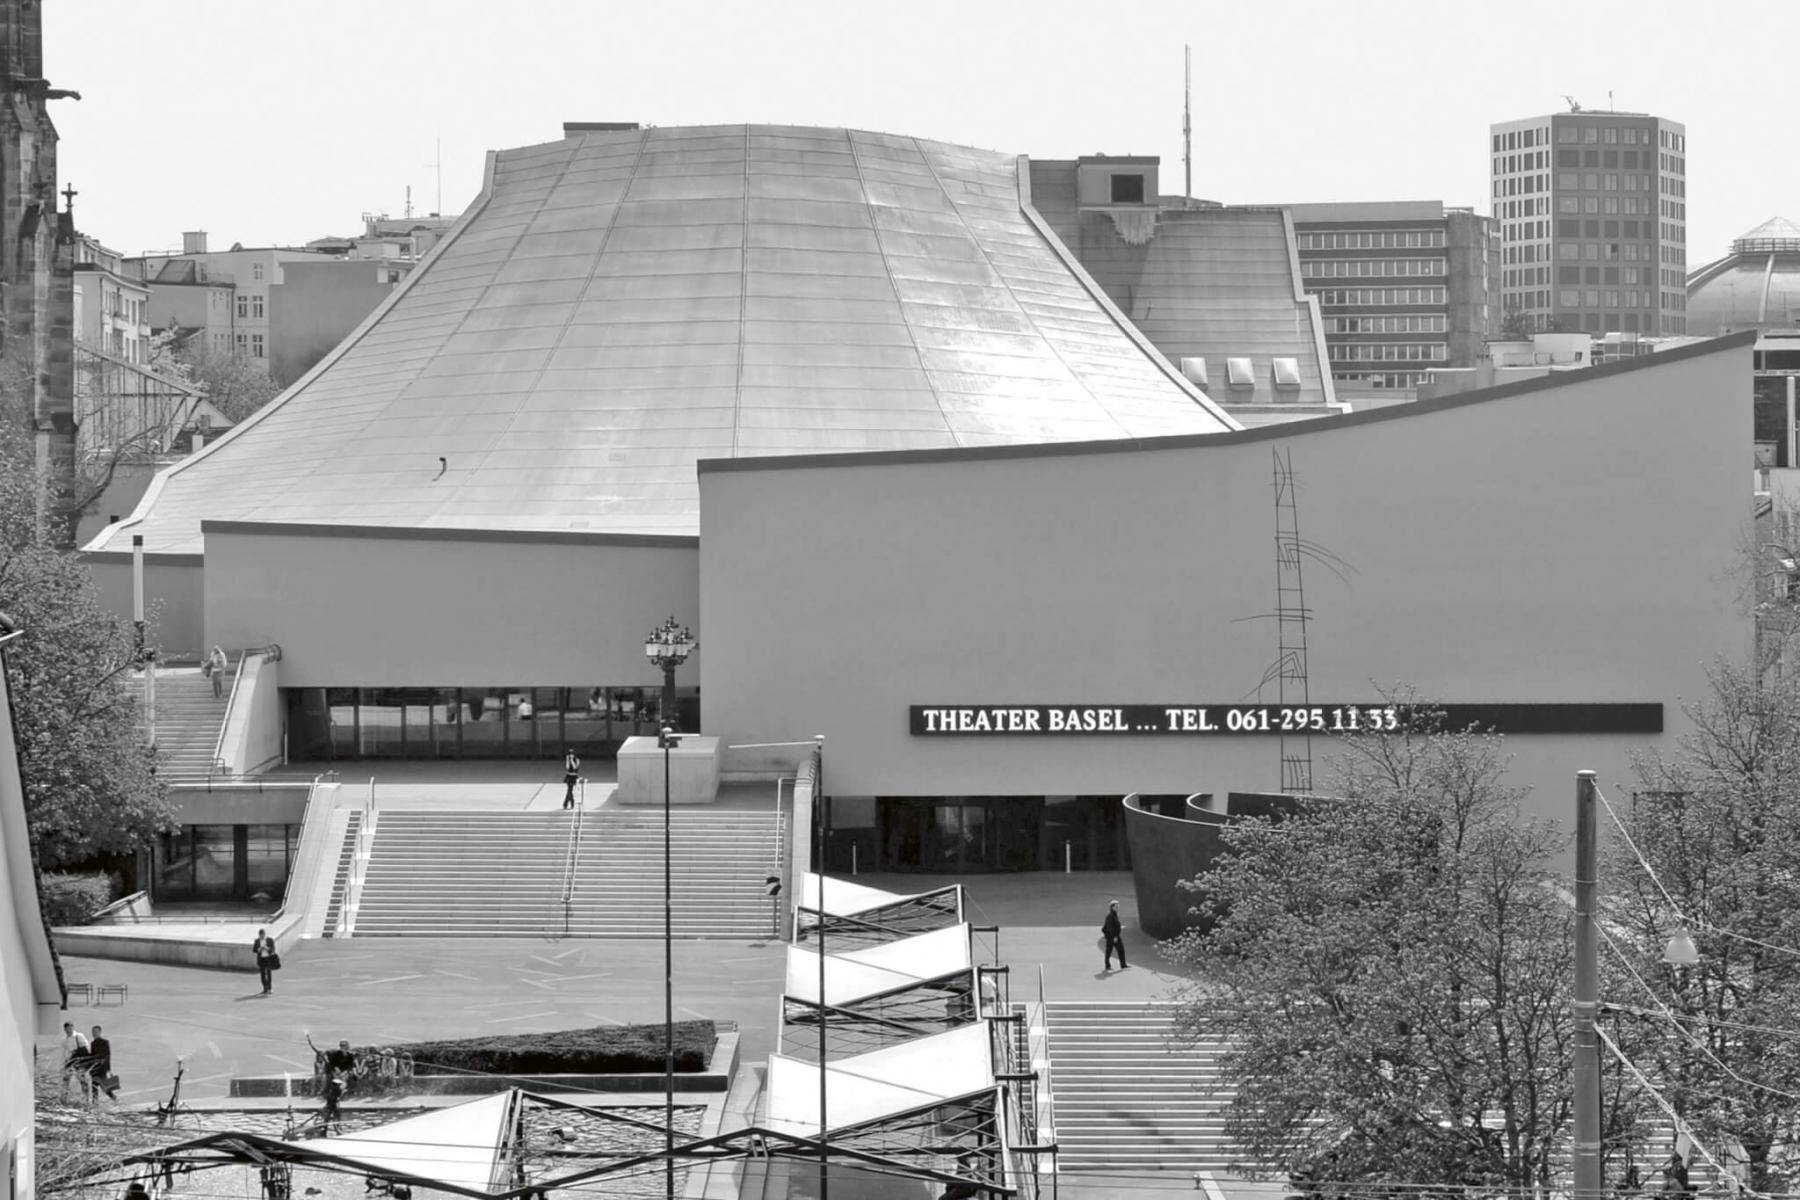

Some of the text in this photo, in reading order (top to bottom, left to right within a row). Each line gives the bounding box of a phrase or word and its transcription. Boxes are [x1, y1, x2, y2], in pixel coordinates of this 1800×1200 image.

[922, 709, 1041, 731] THEATER
[1048, 709, 1129, 731] BASEL
[1165, 709, 1219, 731] TEL.
[1226, 709, 1325, 731] 061-295
[1331, 708, 1360, 730] 11
[1367, 708, 1398, 730] 33
